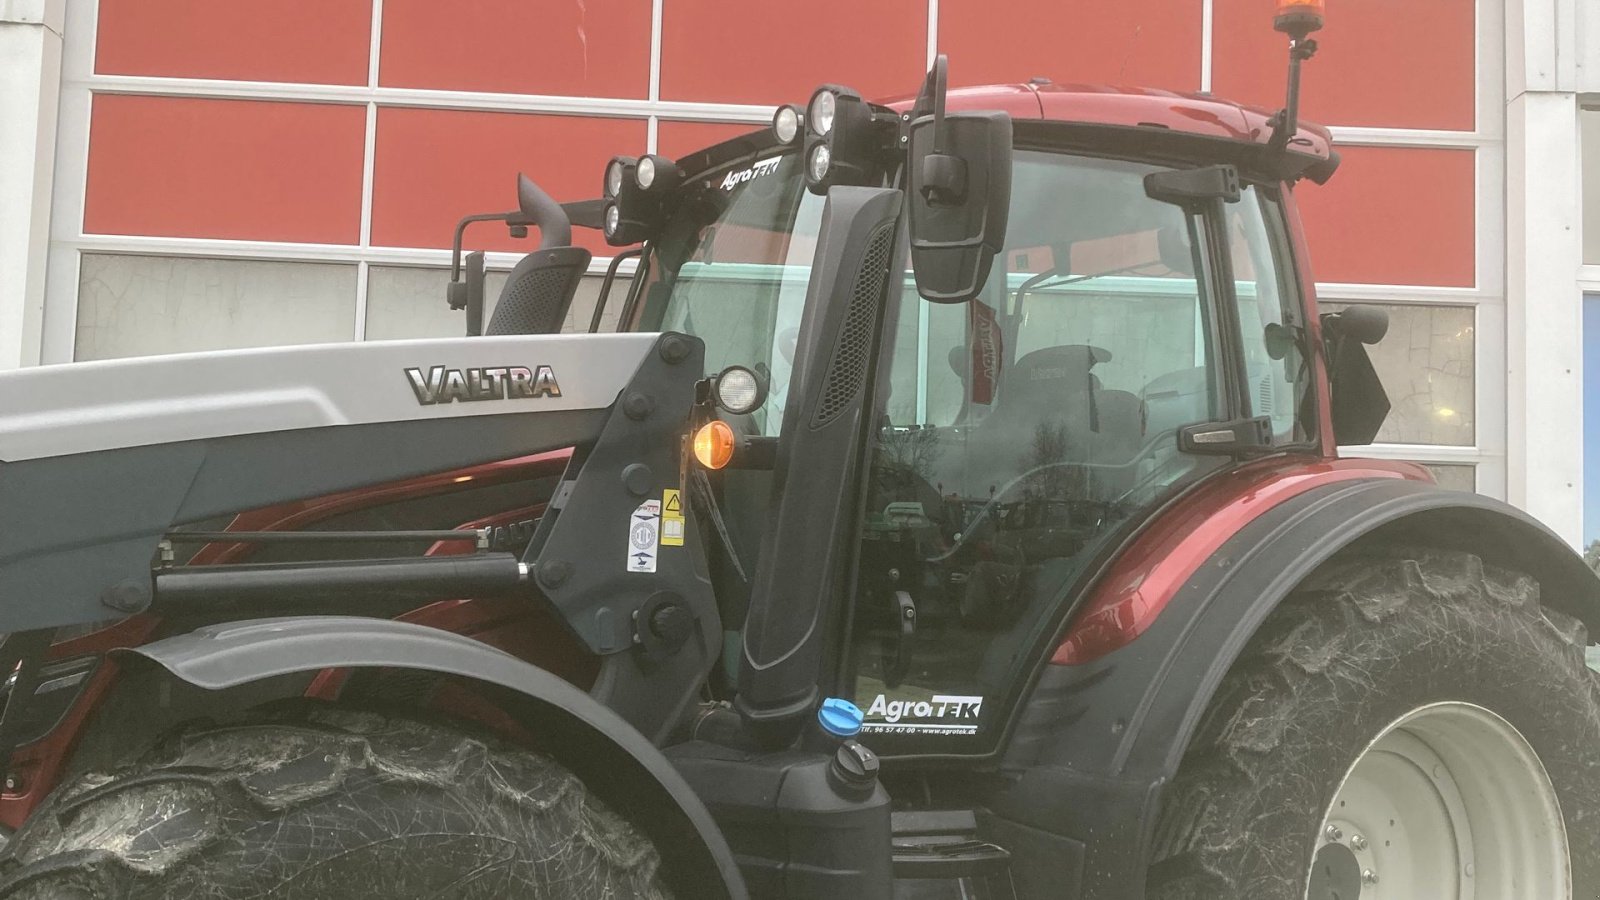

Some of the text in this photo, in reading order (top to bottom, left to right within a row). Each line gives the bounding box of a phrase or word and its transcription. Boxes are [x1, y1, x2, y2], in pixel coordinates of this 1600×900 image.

[720, 155, 782, 191] AgroTEK
[403, 365, 562, 406] VALTRA
[867, 694, 983, 723] AgroTEK
[922, 728, 977, 736] www.agrotek.dk
